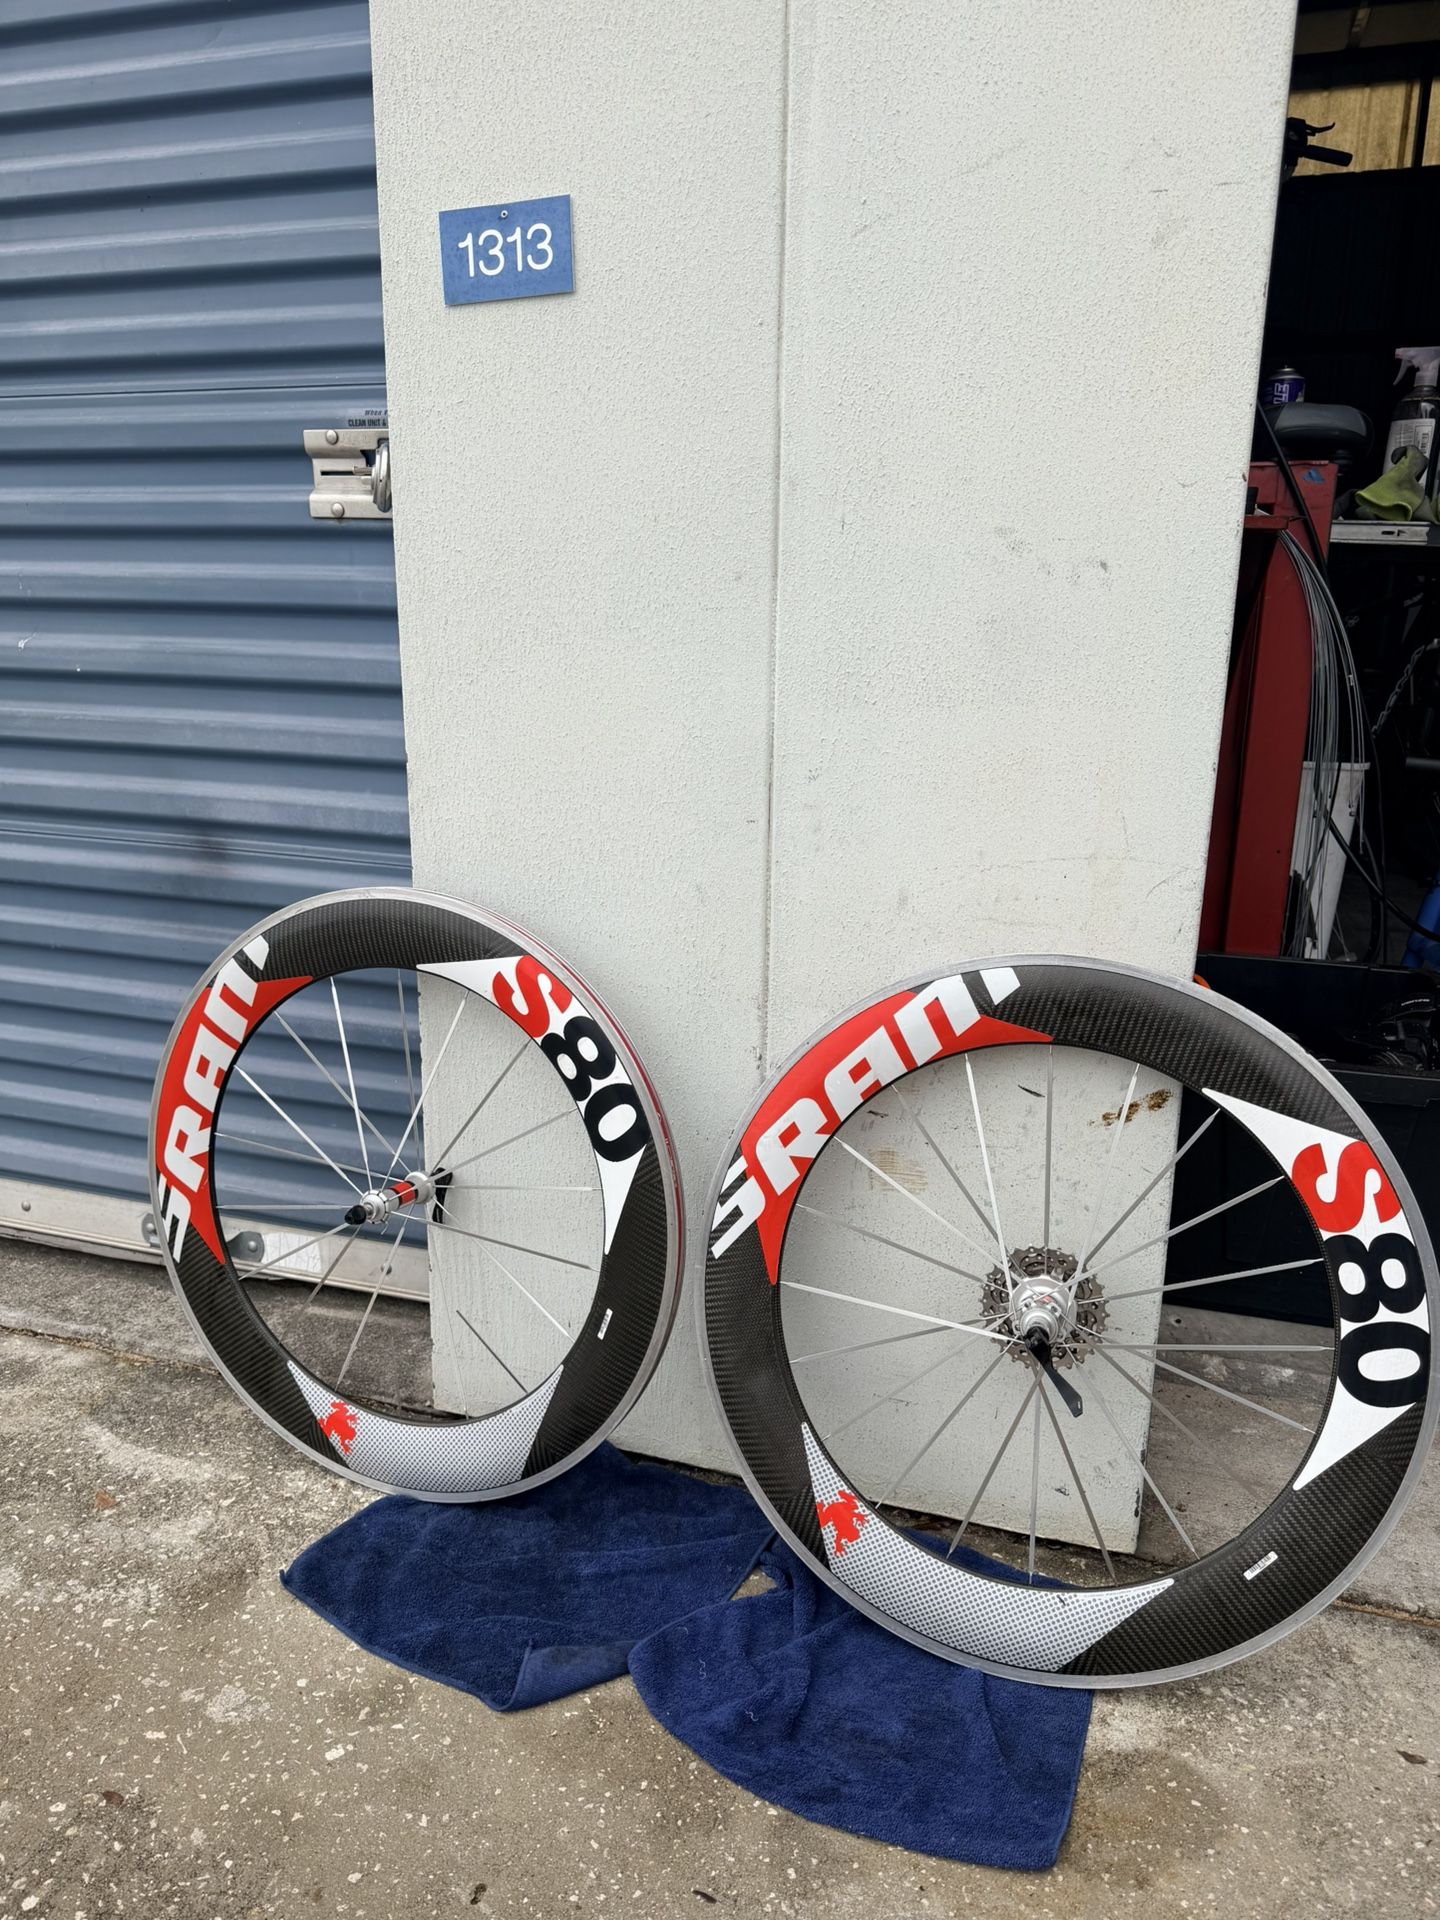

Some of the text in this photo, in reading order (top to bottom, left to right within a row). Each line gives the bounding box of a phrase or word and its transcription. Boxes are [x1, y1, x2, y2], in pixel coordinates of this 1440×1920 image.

[457, 222, 553, 278] 1313
[348, 418, 367, 427] CLEAN
[367, 418, 381, 427] UNIT
[158, 935, 269, 1263] SRAM
[492, 955, 652, 1163] S80
[711, 967, 1020, 1259] SRAM
[1292, 1140, 1431, 1408] S80
